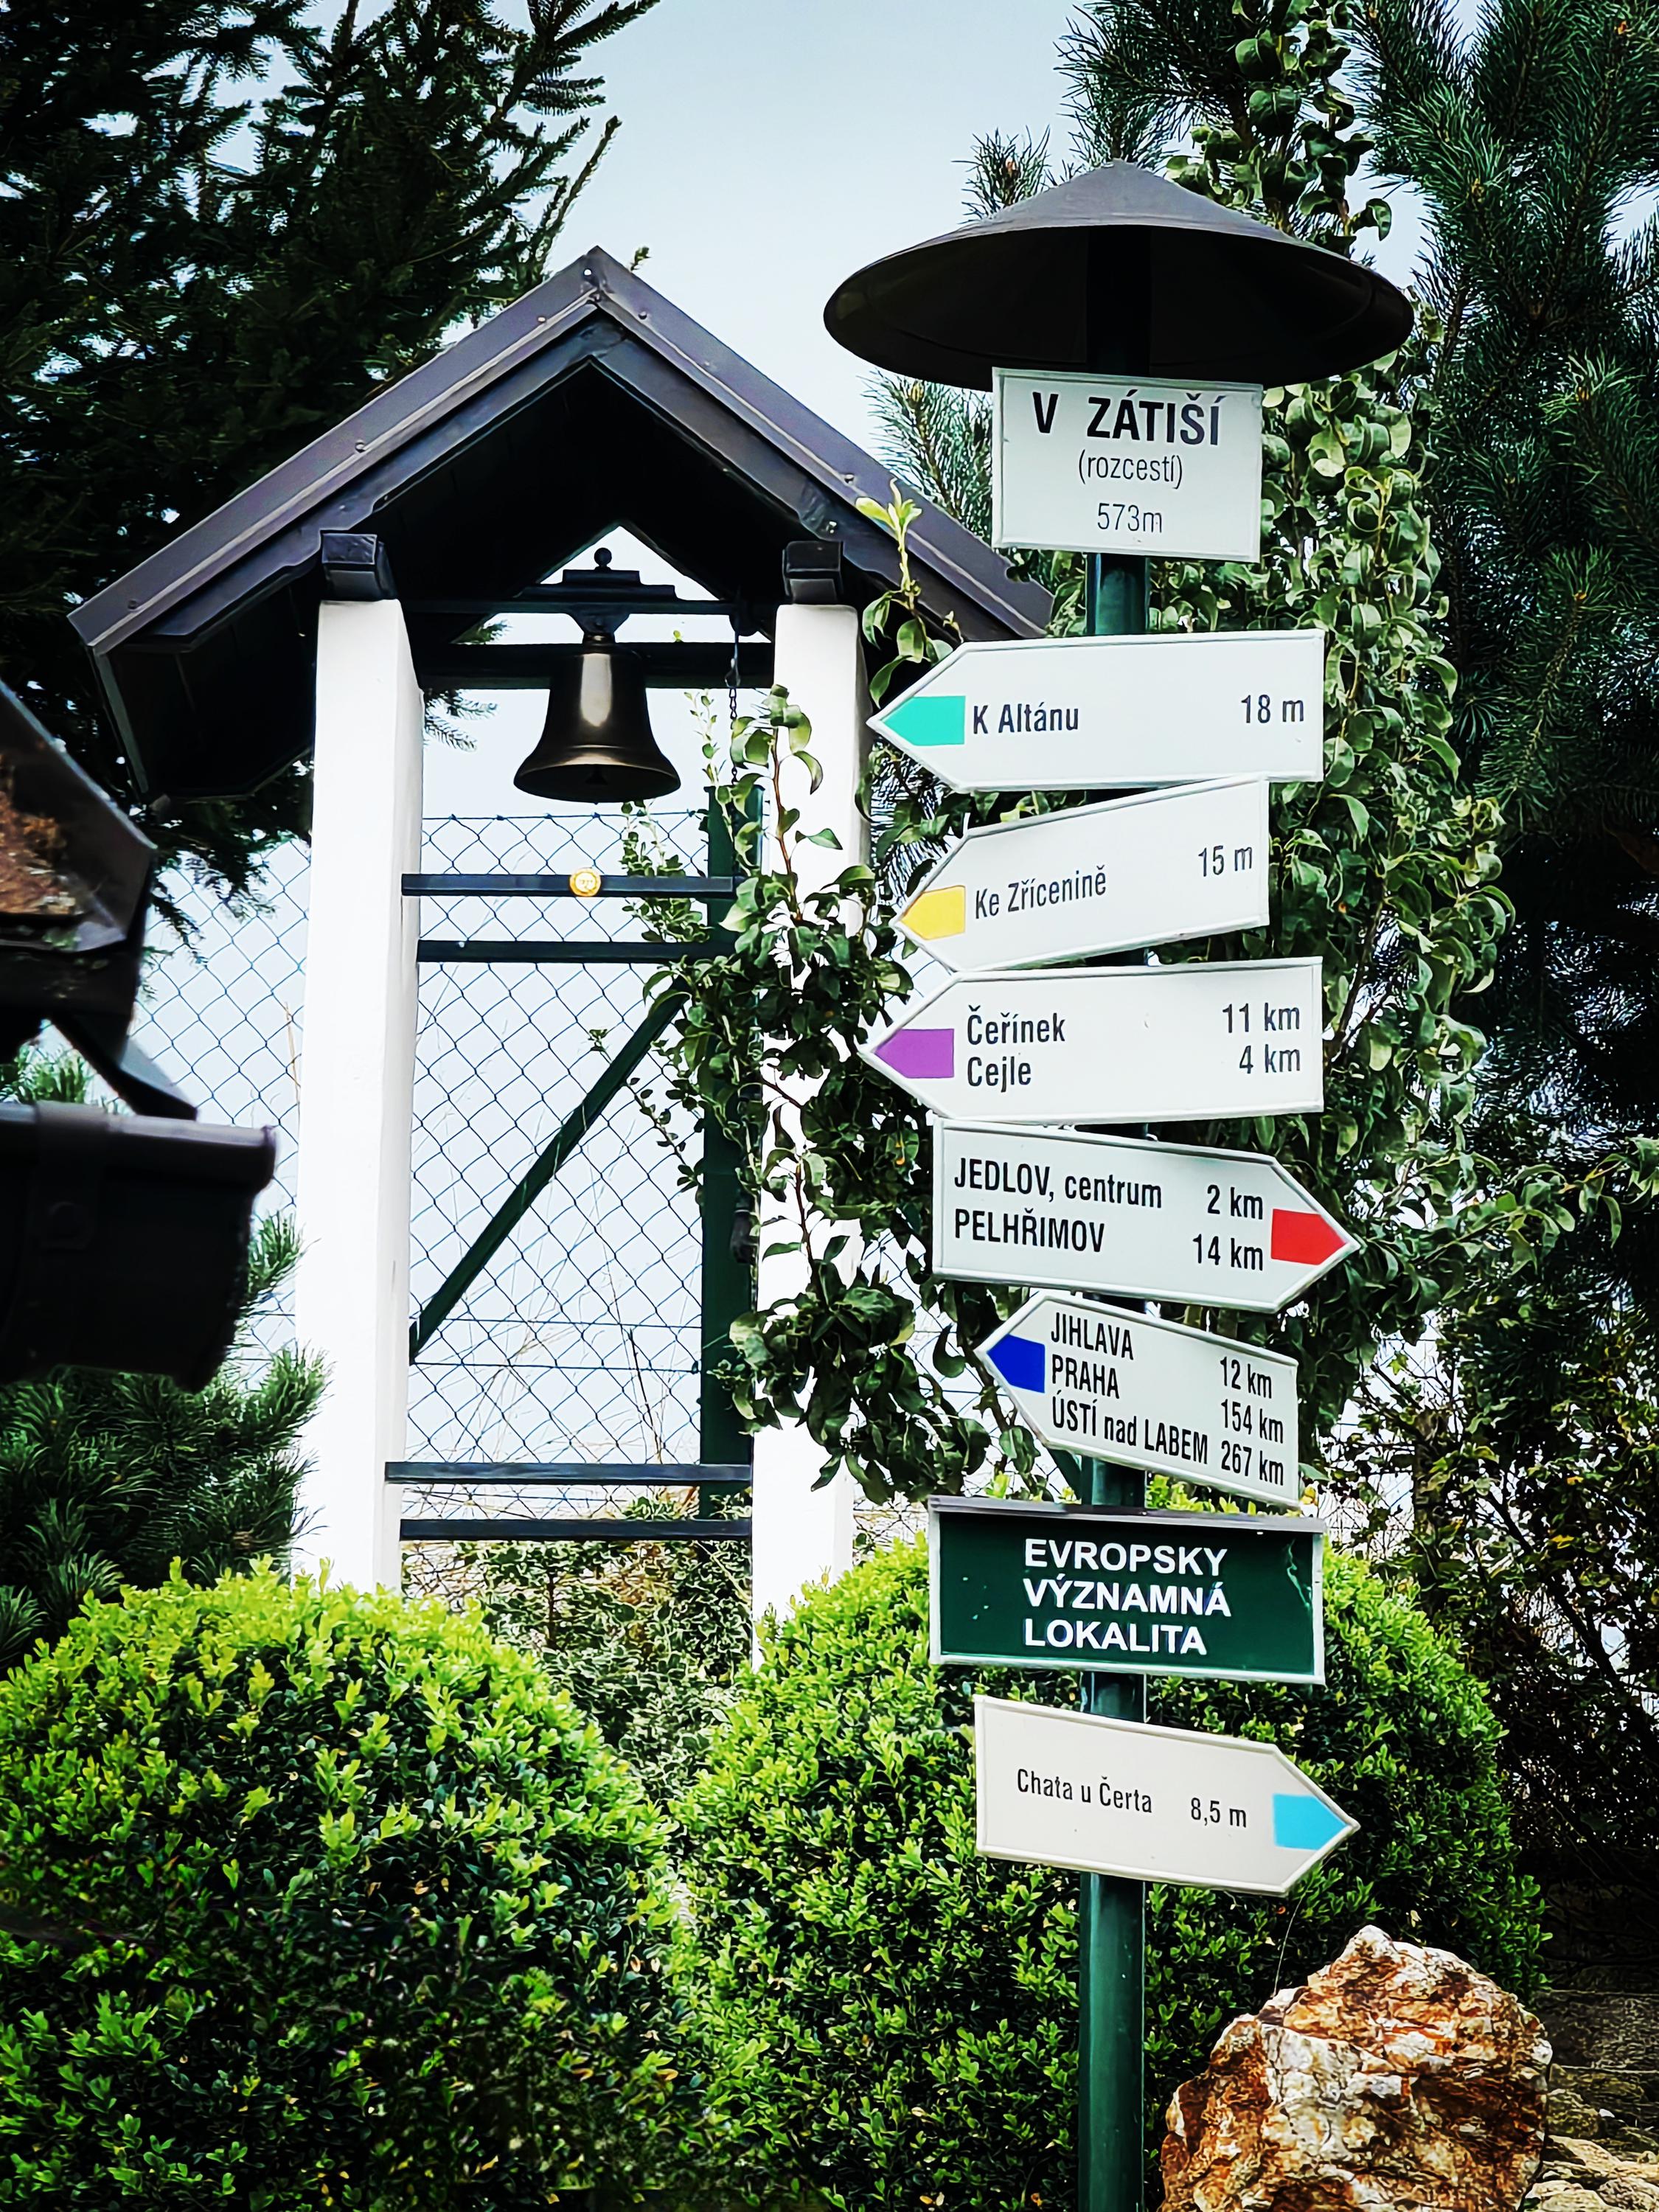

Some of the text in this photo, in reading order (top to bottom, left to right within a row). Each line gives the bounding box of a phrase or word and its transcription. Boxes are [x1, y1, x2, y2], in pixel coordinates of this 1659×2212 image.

[1032, 389, 1227, 445] V ZÁTIŠÍ
[1078, 449, 1183, 490] (rozcestí)
[973, 694, 1304, 734] K Altánu 18 m
[975, 846, 1253, 919] Ke Zřícenině 15 m
[967, 1002, 1300, 1046] Čeřínek 11 km
[967, 1043, 1301, 1093] Cejle 4 km
[954, 1157, 1263, 1220] JEDLOV, centrum 2 km
[955, 1207, 1263, 1271] PELHŘIMOV 14 km
[1051, 1312, 1272, 1399] JIHLAVA 12 km
[1051, 1354, 1284, 1444] PRAHA 154 km
[1051, 1390, 1284, 1486] ÚSTÍ nad LABEM 267 km
[1025, 1538, 1228, 1576] EVROPSKY
[1023, 1573, 1231, 1617] VÝZNAMNÁ
[1025, 1618, 1207, 1655] LOKALITA
[1017, 1768, 1247, 1829] Chata u Čerta 8,5 m
